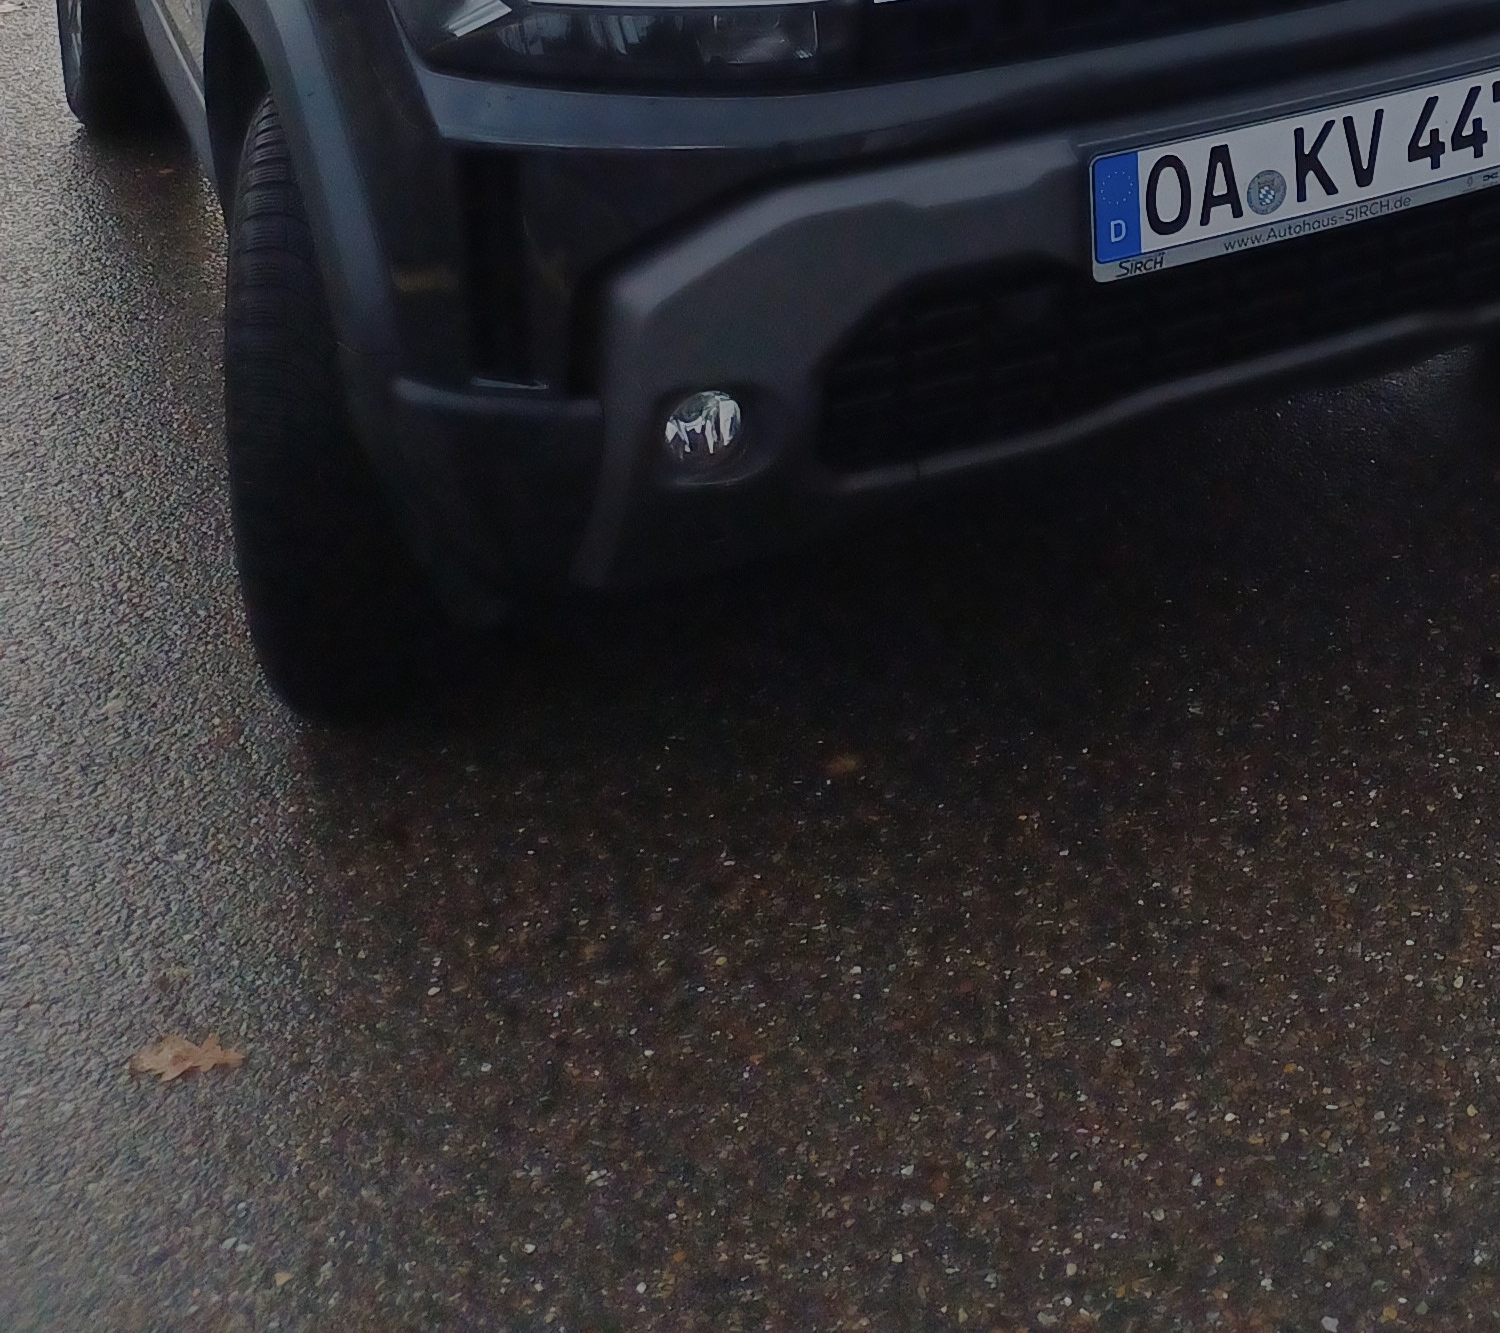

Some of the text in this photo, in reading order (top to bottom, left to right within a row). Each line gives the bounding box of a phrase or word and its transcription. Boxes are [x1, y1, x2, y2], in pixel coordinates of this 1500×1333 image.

[1146, 144, 1243, 235] OA
[1294, 109, 1384, 202] KV
[1110, 220, 1127, 243] D
[1223, 196, 1412, 251] www.Autohaus-SIRCH.de
